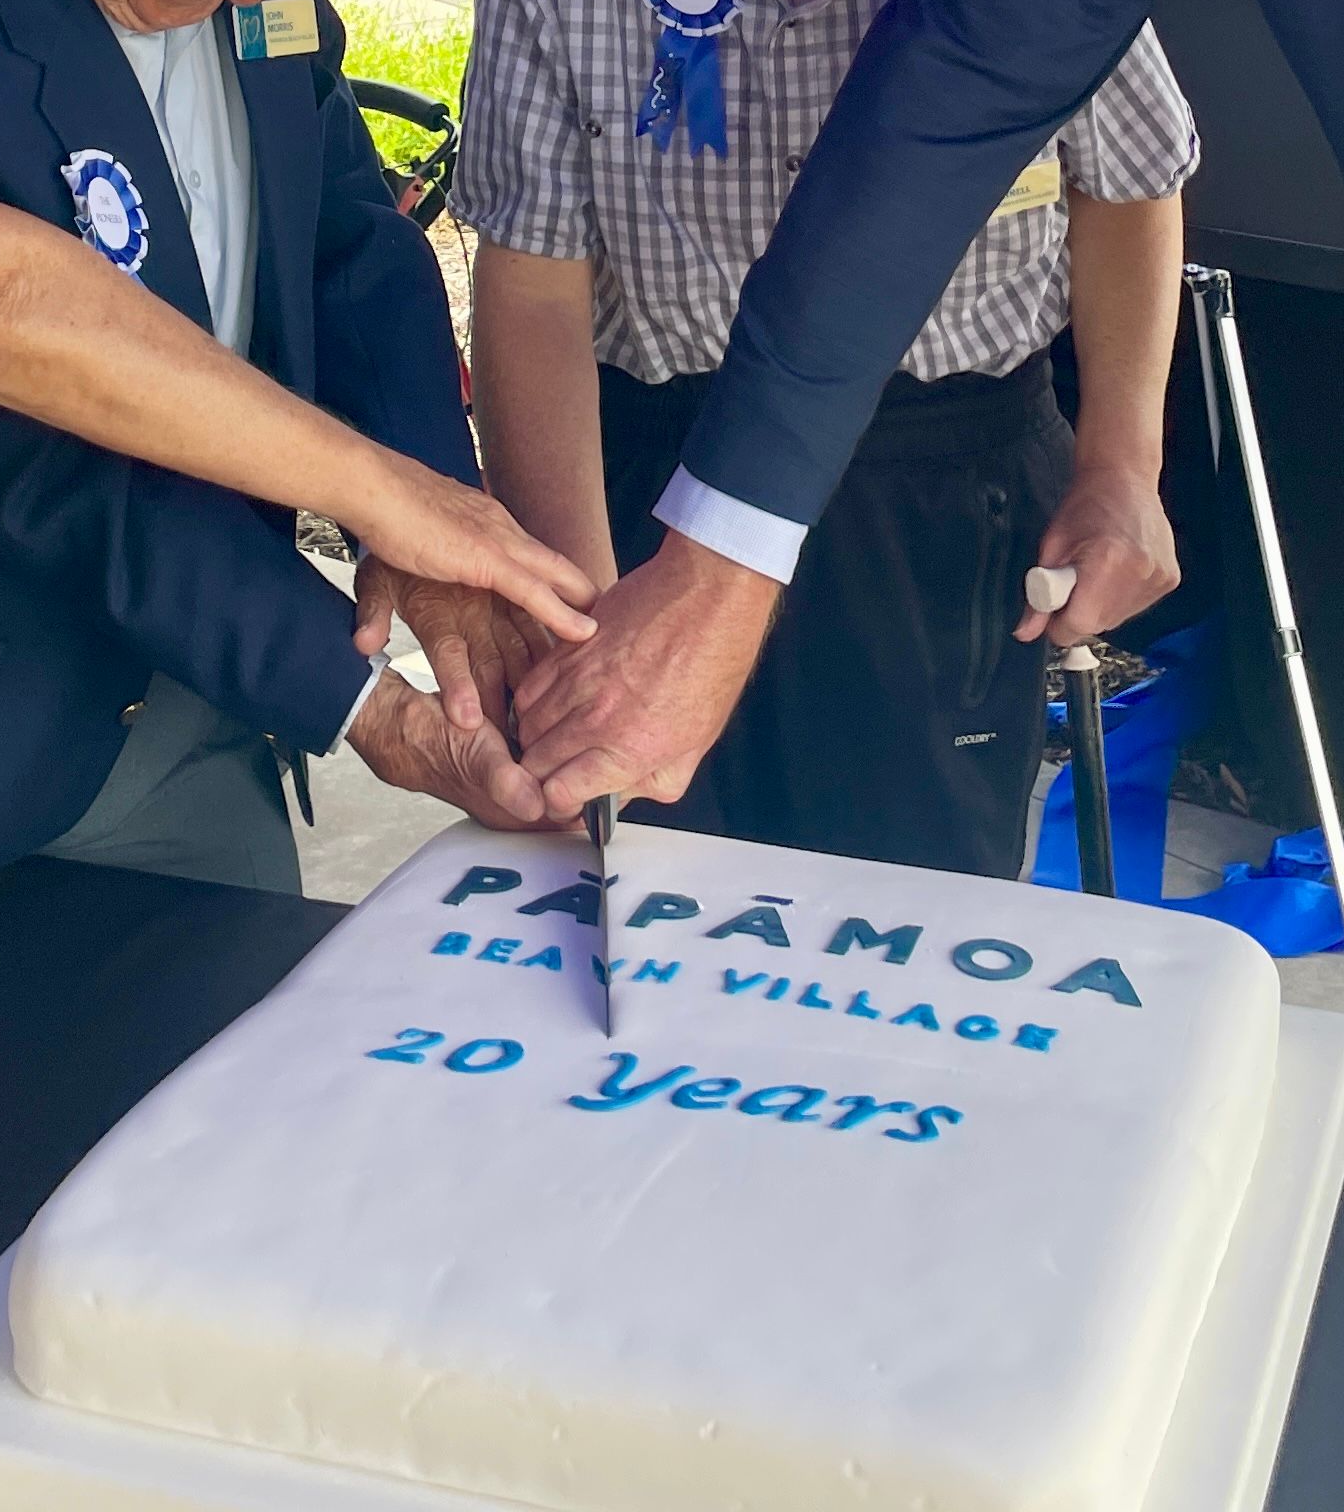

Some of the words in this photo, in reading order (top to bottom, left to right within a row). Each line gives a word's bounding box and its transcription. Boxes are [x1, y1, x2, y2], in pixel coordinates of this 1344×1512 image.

[721, 968, 1060, 1053] VILLAGE
[366, 1028, 525, 1074] 20
[567, 1051, 965, 1143] Years
